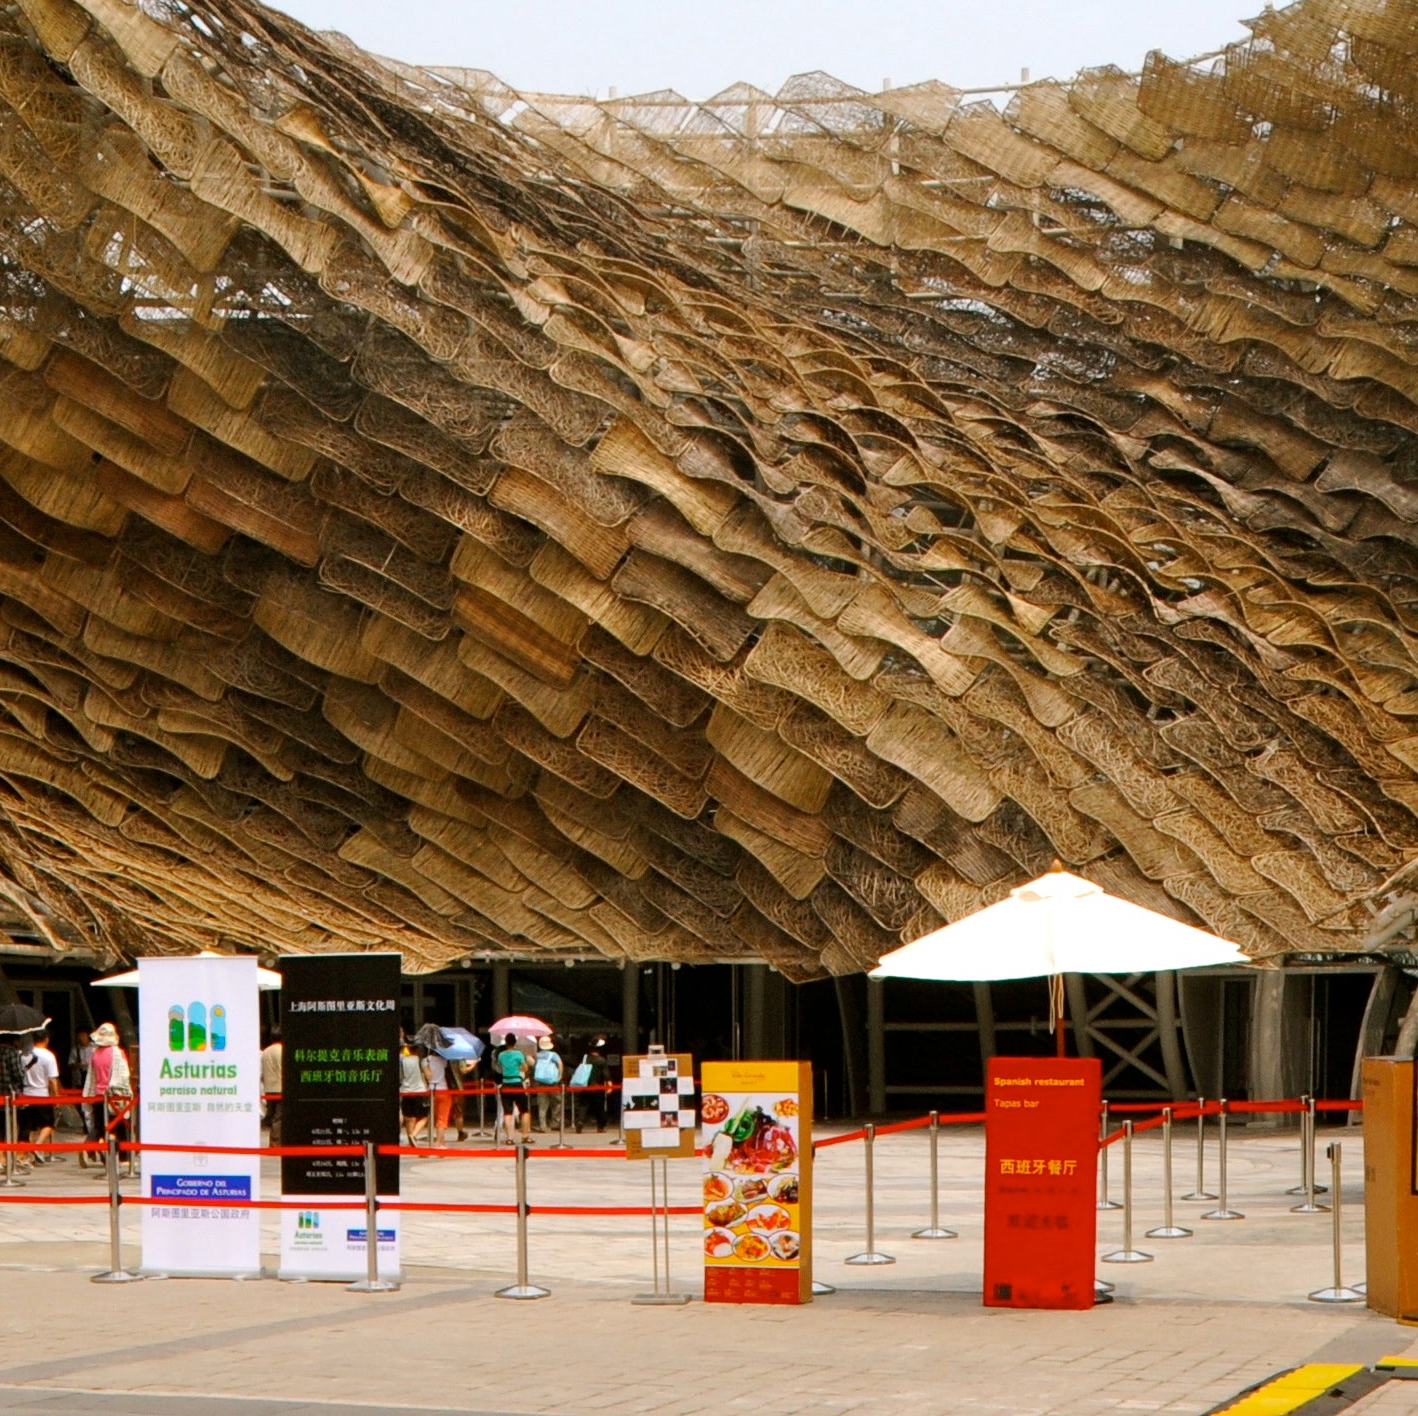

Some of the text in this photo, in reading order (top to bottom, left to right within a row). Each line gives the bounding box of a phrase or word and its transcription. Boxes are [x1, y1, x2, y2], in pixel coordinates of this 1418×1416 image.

[159, 1057, 237, 1079] Asturias
[300, 1069, 383, 1083] 西班牙馆音乐厅
[993, 1077, 1085, 1087] Spanish restaurant
[199, 1085, 237, 1095] natural
[993, 1098, 1040, 1109] Tapas bar
[999, 1158, 1078, 1176] 西班牙餐厅
